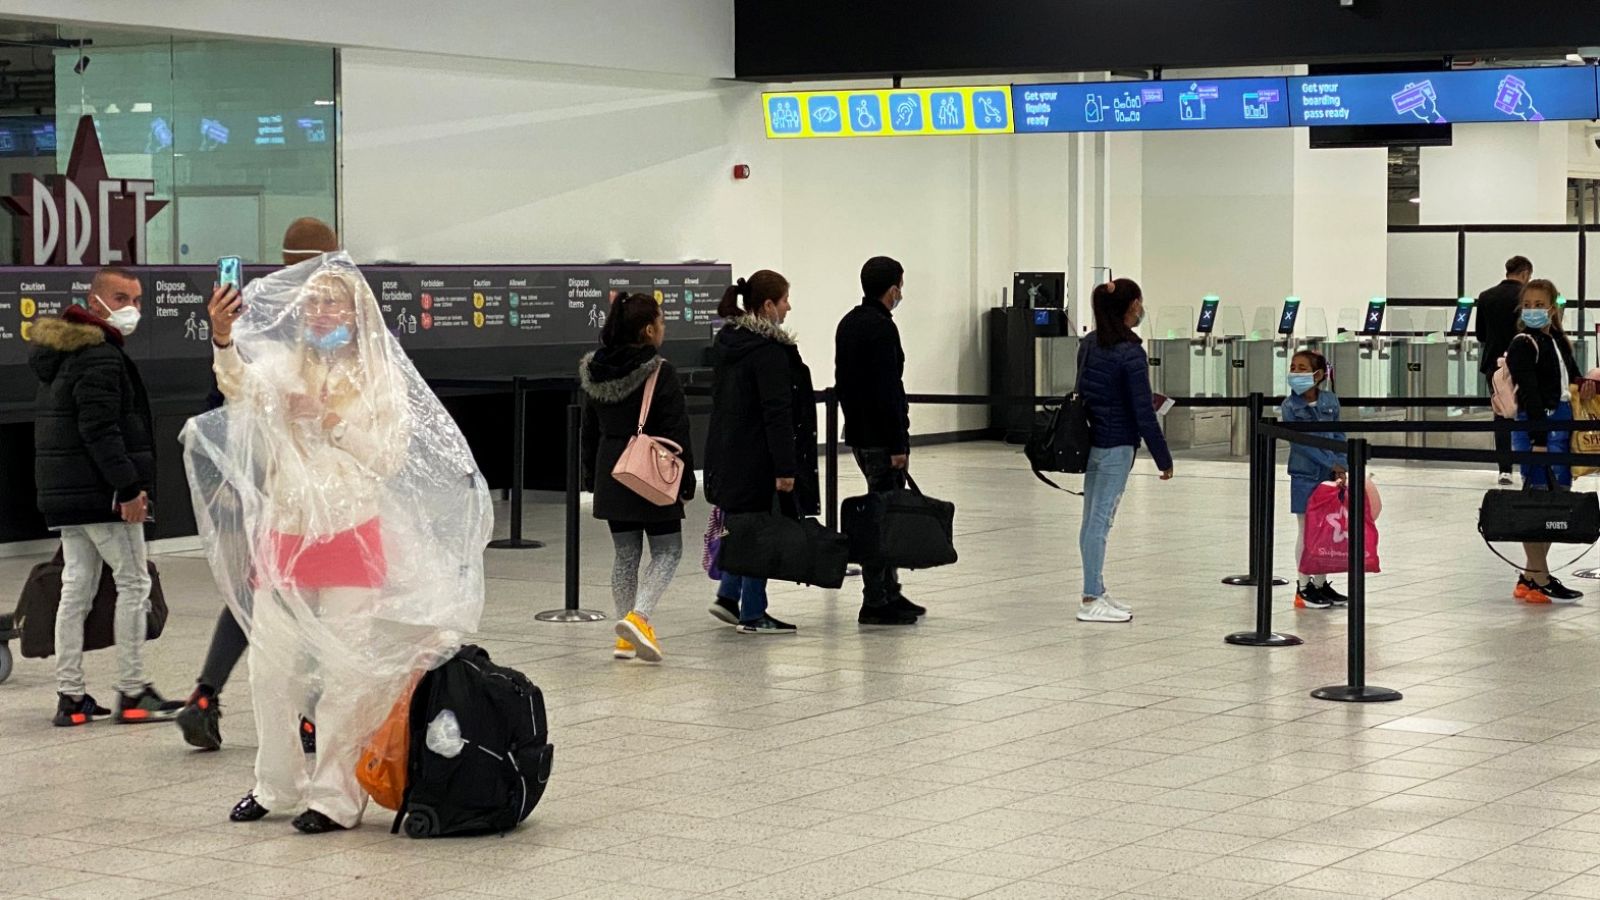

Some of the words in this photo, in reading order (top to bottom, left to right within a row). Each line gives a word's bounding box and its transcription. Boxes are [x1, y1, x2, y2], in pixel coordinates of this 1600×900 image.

[1302, 83, 1318, 93] Get
[1318, 83, 1338, 94] your
[1024, 91, 1039, 101] Get
[1039, 92, 1058, 102] your
[1303, 95, 1340, 107] boarding
[1304, 110, 1324, 120] pass
[1325, 108, 1349, 119] ready
[1026, 115, 1049, 127] ready
[20, 282, 46, 291] Caution
[71, 281, 92, 290] Allowe
[156, 280, 186, 293] Dispose
[473, 279, 491, 287] Caution
[568, 278, 589, 289] Dispose
[156, 293, 165, 304] of
[166, 293, 203, 304] forbidden
[382, 291, 412, 301] forbidden
[568, 288, 576, 298] of
[576, 288, 602, 298] forbidden
[568, 299, 584, 308] items
[156, 306, 178, 317] items
[1545, 521, 1568, 530] SPORTS
